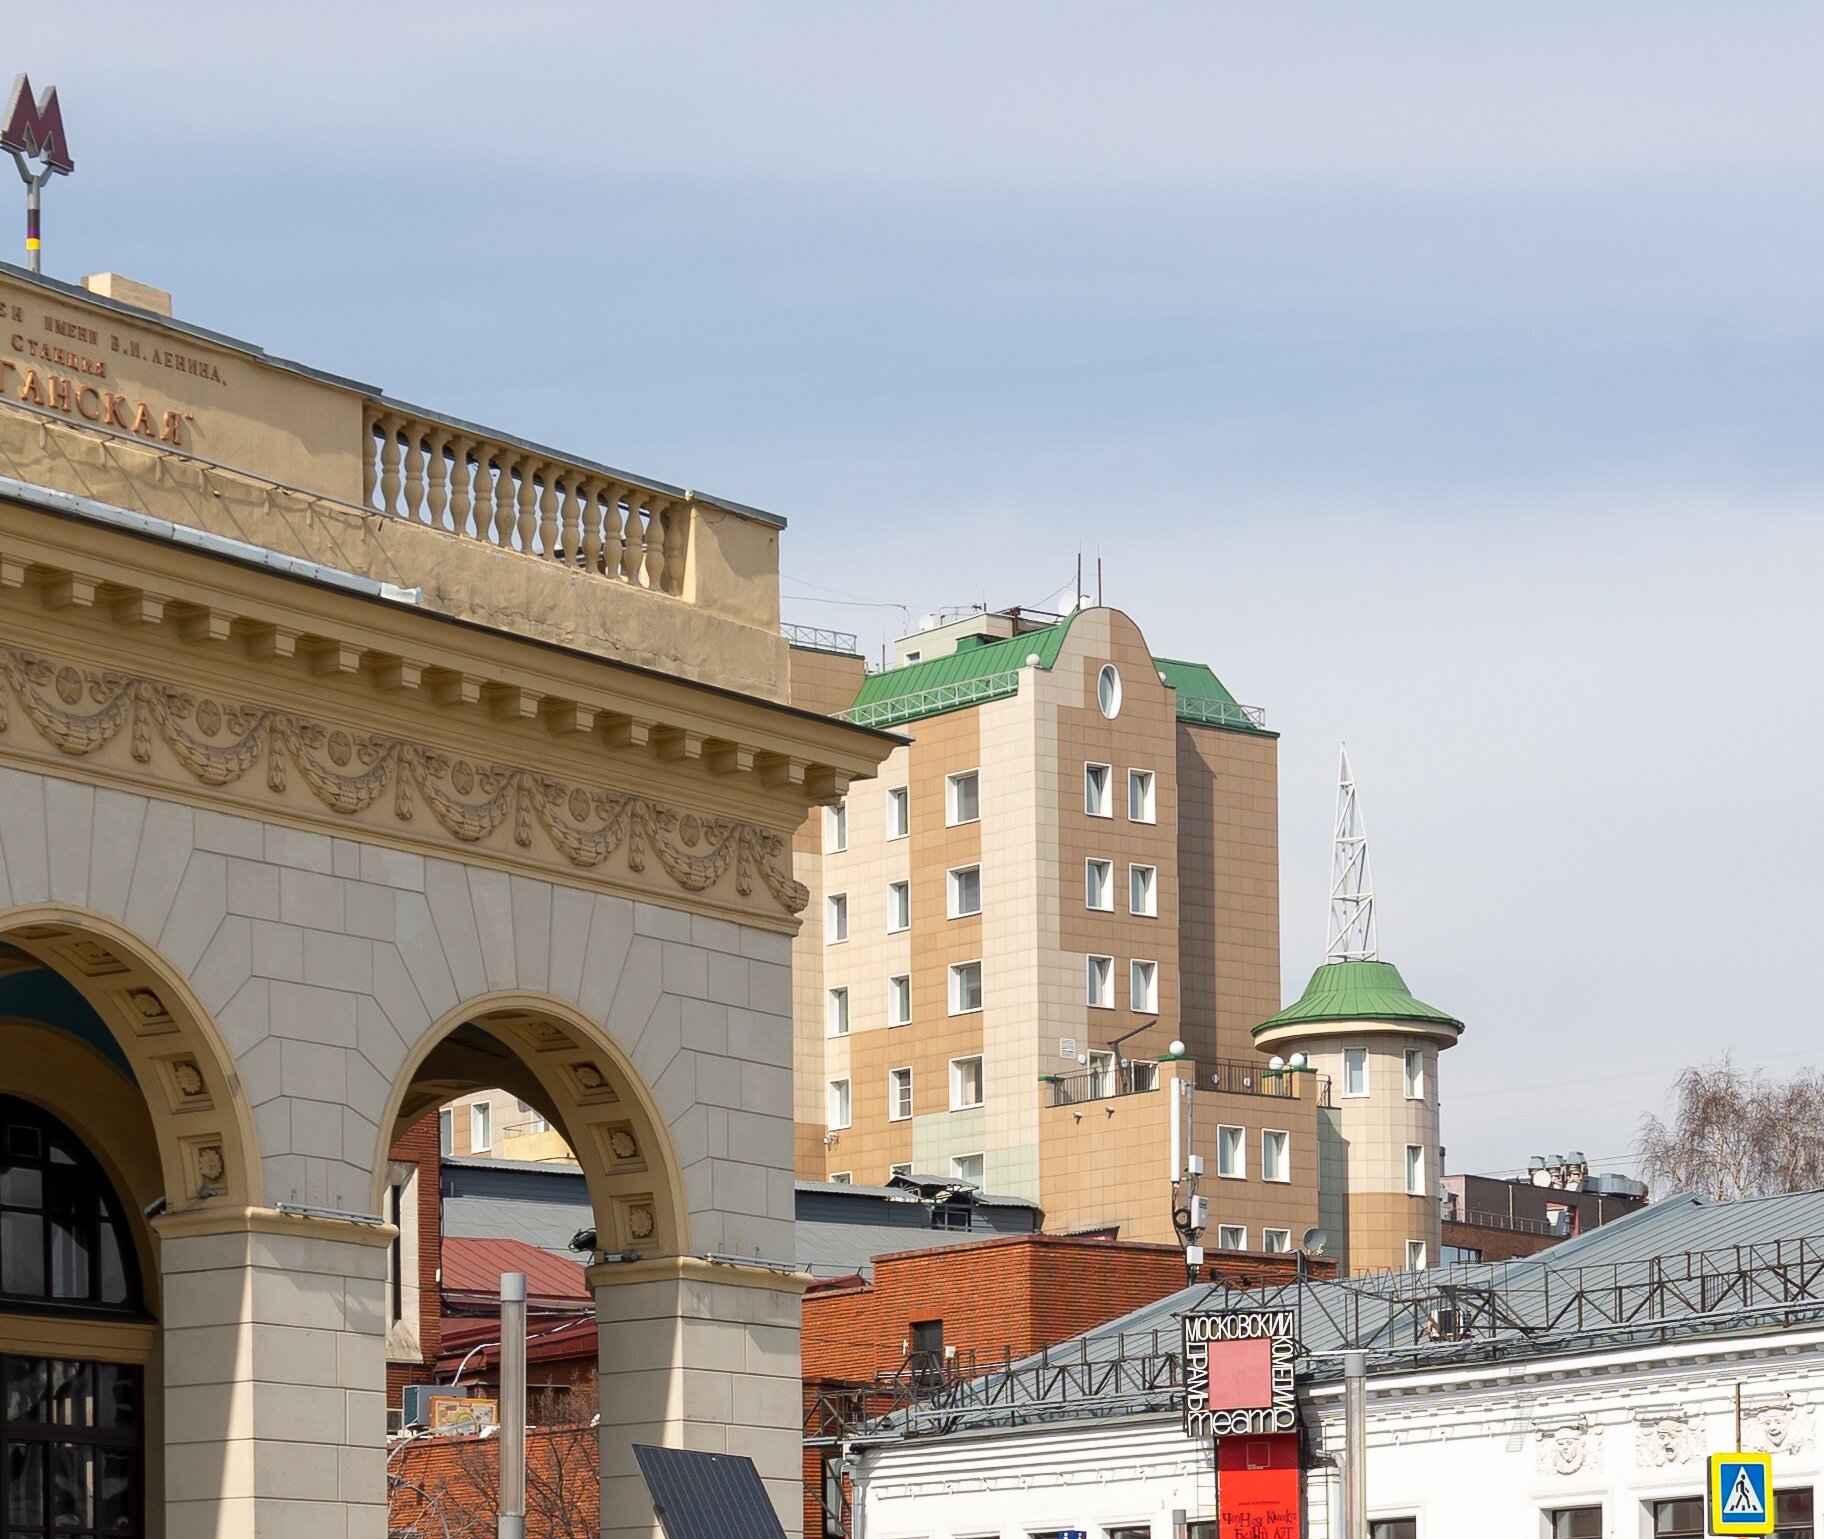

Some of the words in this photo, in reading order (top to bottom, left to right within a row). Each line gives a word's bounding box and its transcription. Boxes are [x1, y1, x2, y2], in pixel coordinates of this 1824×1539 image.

[44, 315, 98, 346] ИМЕНИ
[11, 334, 107, 378] СТАНЦИЯ
[1185, 1312, 1293, 1342] МОСКОВСКИЙ
[1271, 1336, 1295, 1410] КОМЕДИИ
